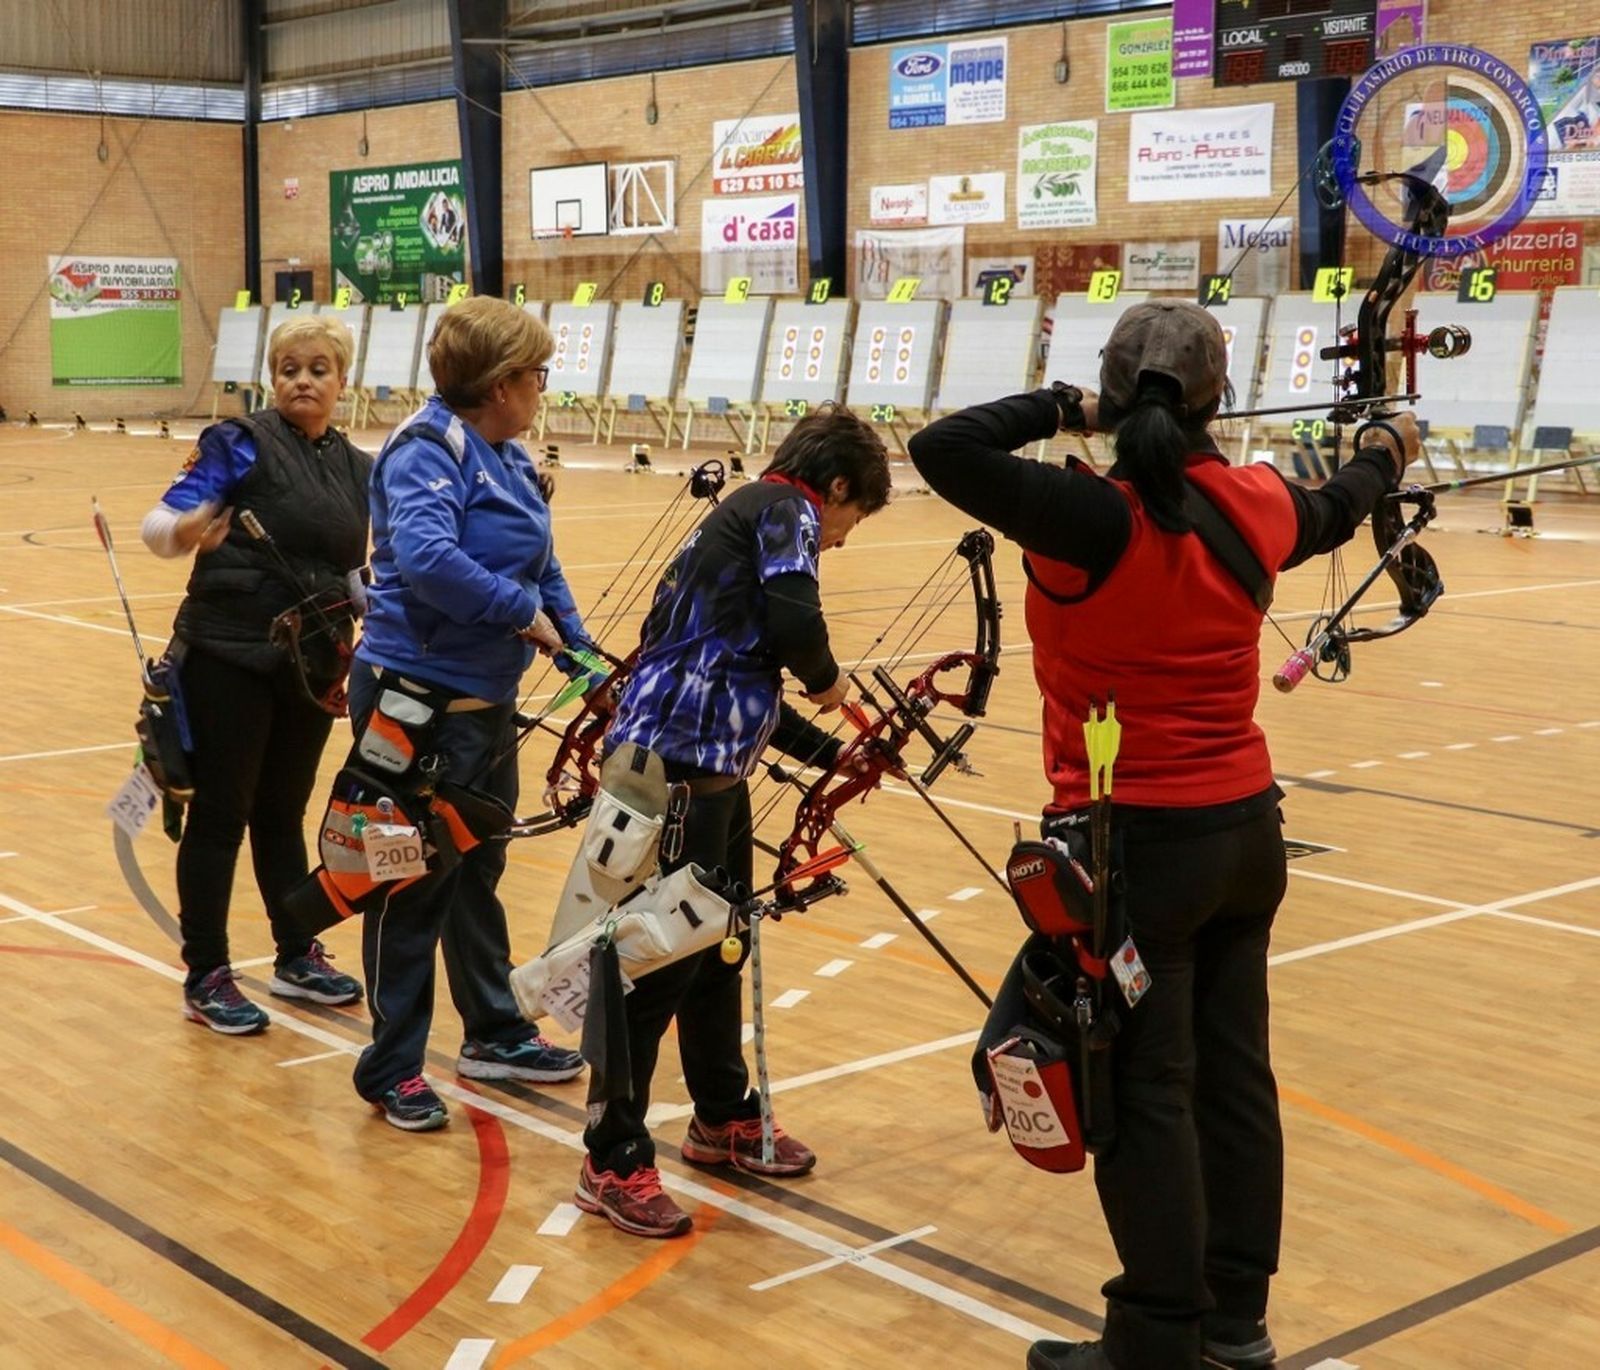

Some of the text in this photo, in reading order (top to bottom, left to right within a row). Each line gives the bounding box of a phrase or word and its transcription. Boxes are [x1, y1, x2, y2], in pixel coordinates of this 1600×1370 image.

[1323, 17, 1367, 35] VISITANTE
[1223, 30, 1264, 46] LOCAL
[1119, 41, 1170, 55] GONZALEZ
[904, 57, 934, 75] Ford
[950, 60, 1004, 85] marpe
[1112, 67, 1129, 78] 954
[1278, 62, 1310, 77] PERIODO
[1131, 79, 1148, 89] 444
[1152, 130, 1250, 144] TALLERES
[1194, 145, 1241, 160] PONCE
[1022, 155, 1092, 174] MORENO
[352, 166, 460, 194] ASPRO ANDALUCIA
[720, 178, 744, 193] 629
[747, 176, 764, 191] 43
[768, 175, 784, 189] 10
[723, 216, 795, 242] d'casa
[1225, 223, 1292, 253] Megar
[1493, 226, 1577, 255] pizzería
[74, 264, 174, 275] ASPRO ANDALUCIA
[1492, 254, 1575, 272] churrería
[100, 276, 174, 287] INMOBILIARIA
[737, 280, 748, 299] 9
[811, 278, 829, 304] 10
[896, 280, 918, 298] 11
[991, 278, 1010, 304] 12
[1098, 274, 1116, 299] 13
[1208, 278, 1230, 303] 14
[1468, 269, 1495, 301] 16
[120, 290, 140, 299] 955
[290, 288, 301, 308] 2
[397, 292, 408, 310] 4
[514, 284, 525, 307] 6
[650, 282, 664, 306] 8
[785, 400, 807, 417] 2-0
[871, 403, 894, 422] 2-0
[1292, 419, 1325, 440] 2-0
[375, 846, 420, 867] 20D
[1011, 860, 1043, 878] HOYT
[1006, 1106, 1055, 1133] 20C
